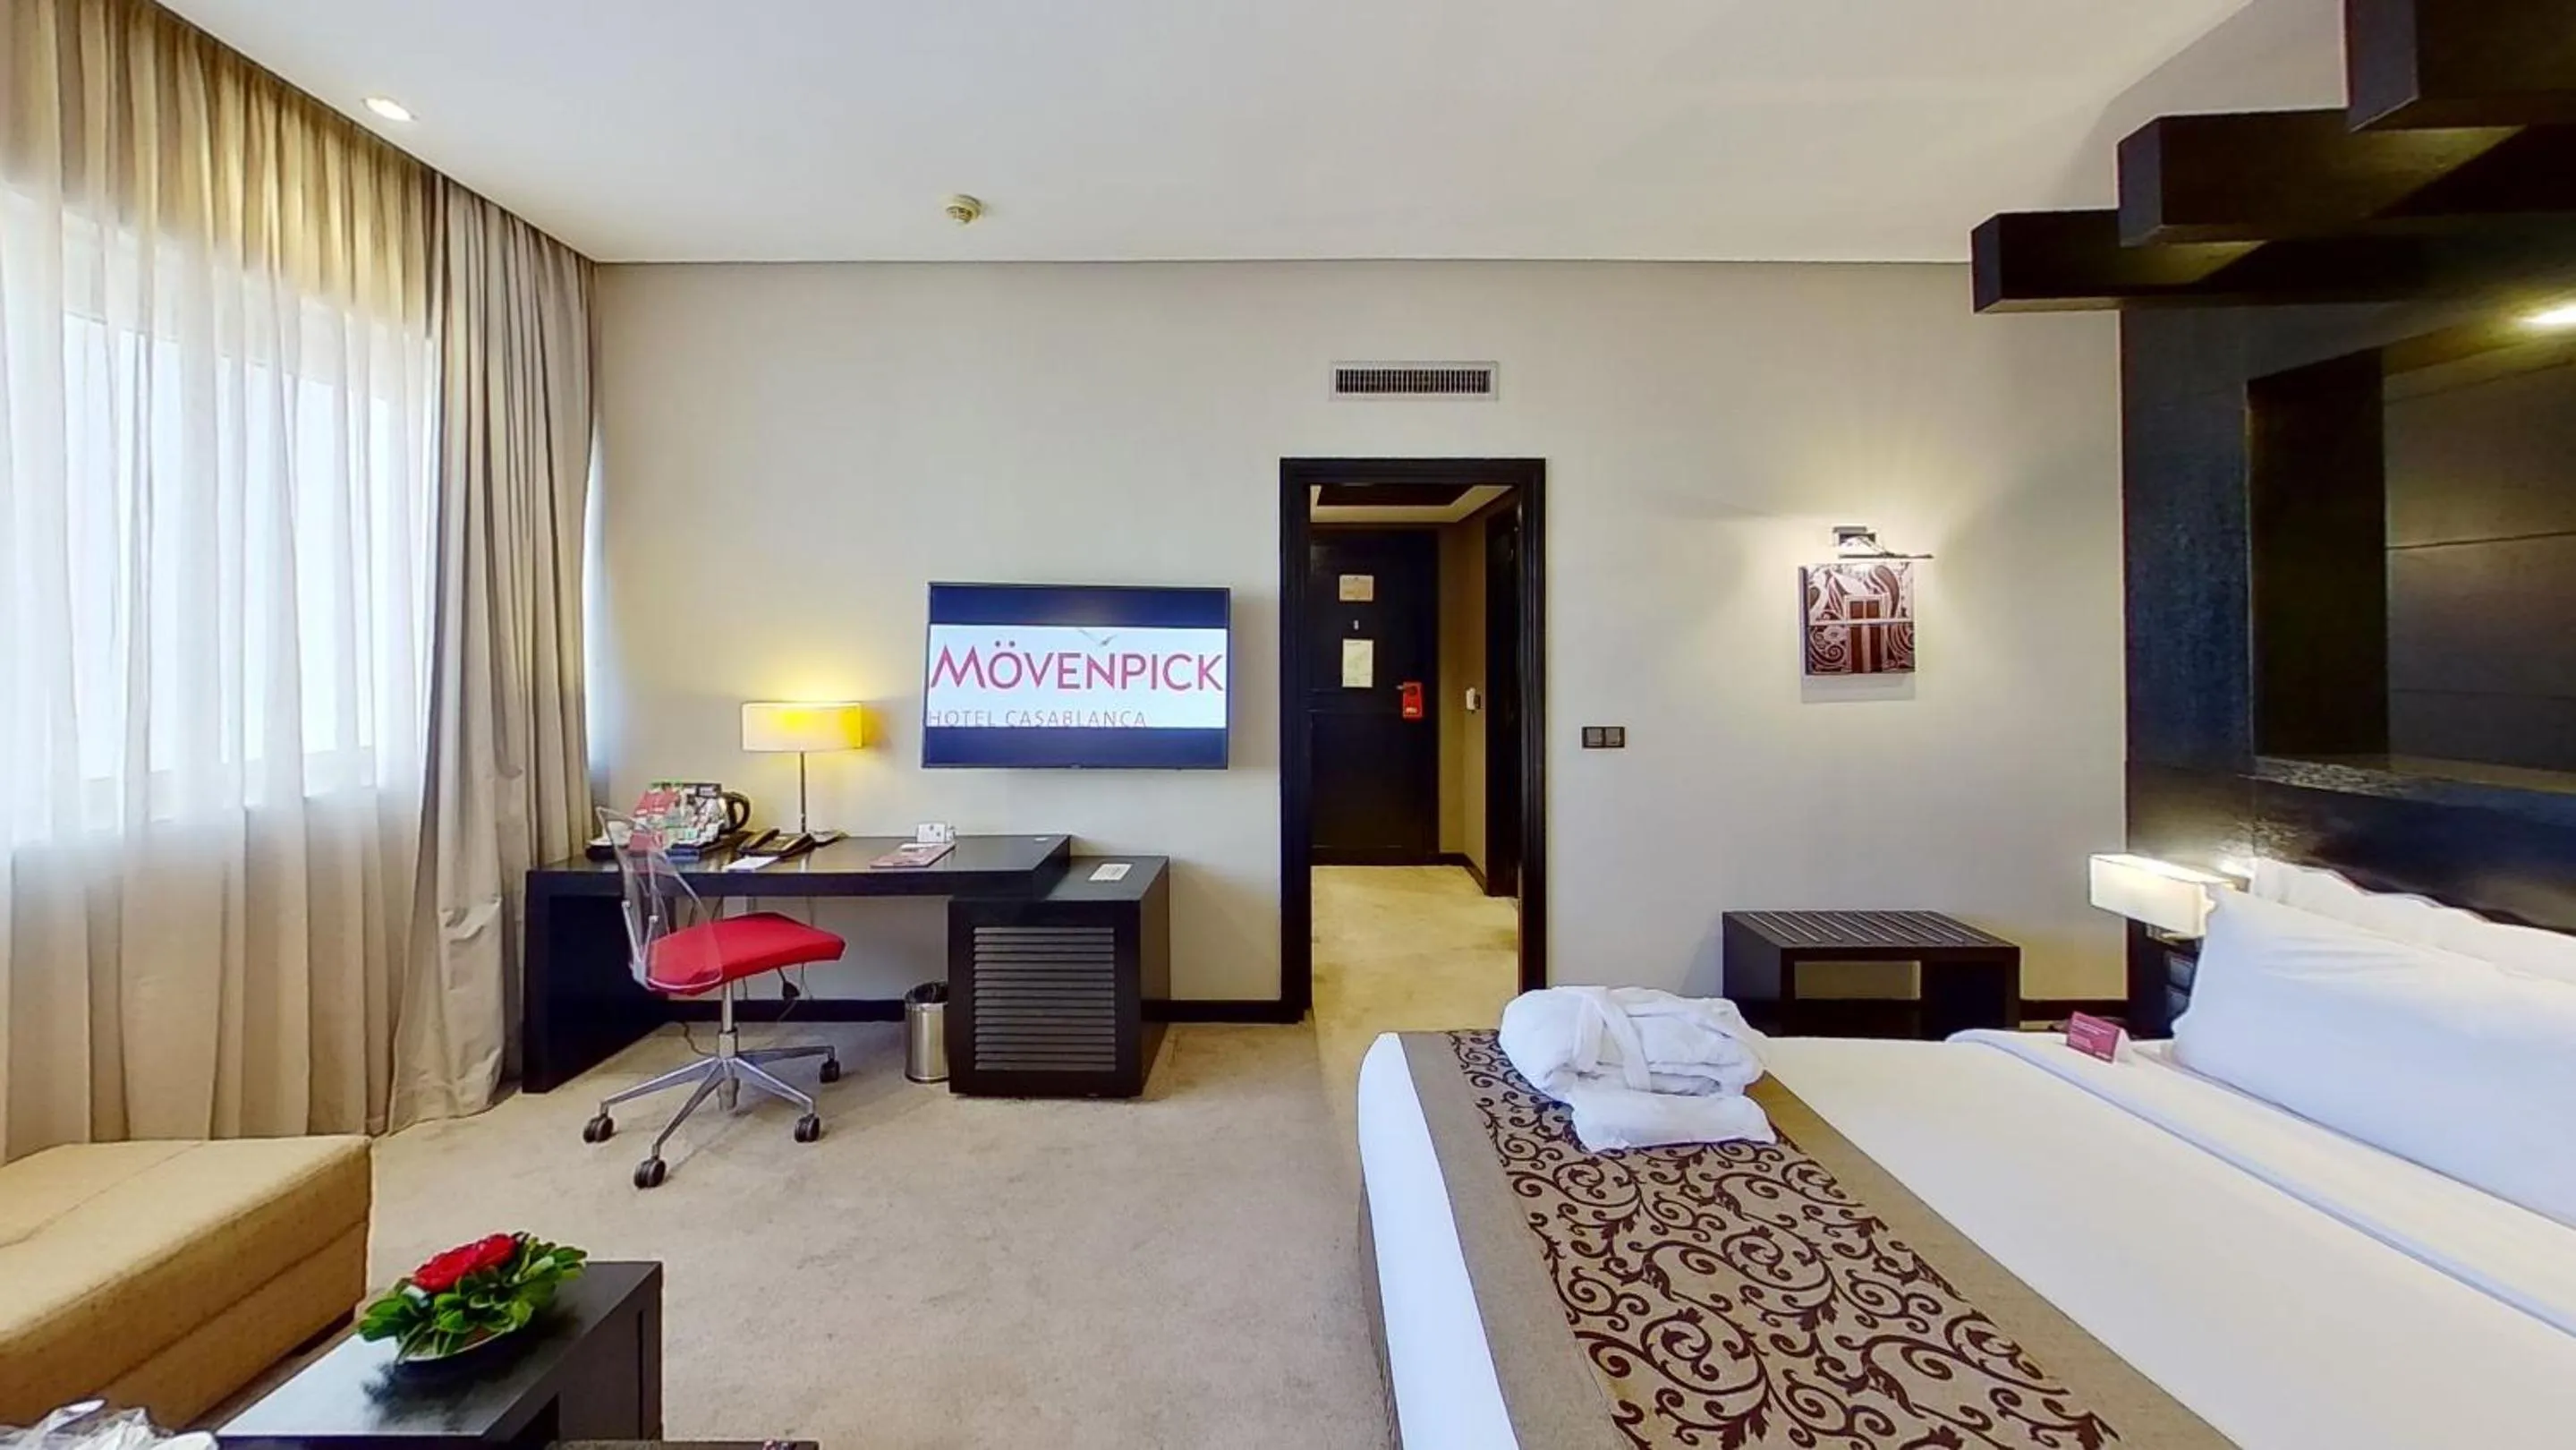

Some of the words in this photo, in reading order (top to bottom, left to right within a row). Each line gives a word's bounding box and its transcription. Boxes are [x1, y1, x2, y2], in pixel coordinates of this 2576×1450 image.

[931, 640, 1223, 691] MÖVENPICK
[928, 711, 995, 728] HOTEL
[1005, 711, 1146, 728] CASABLANCA
